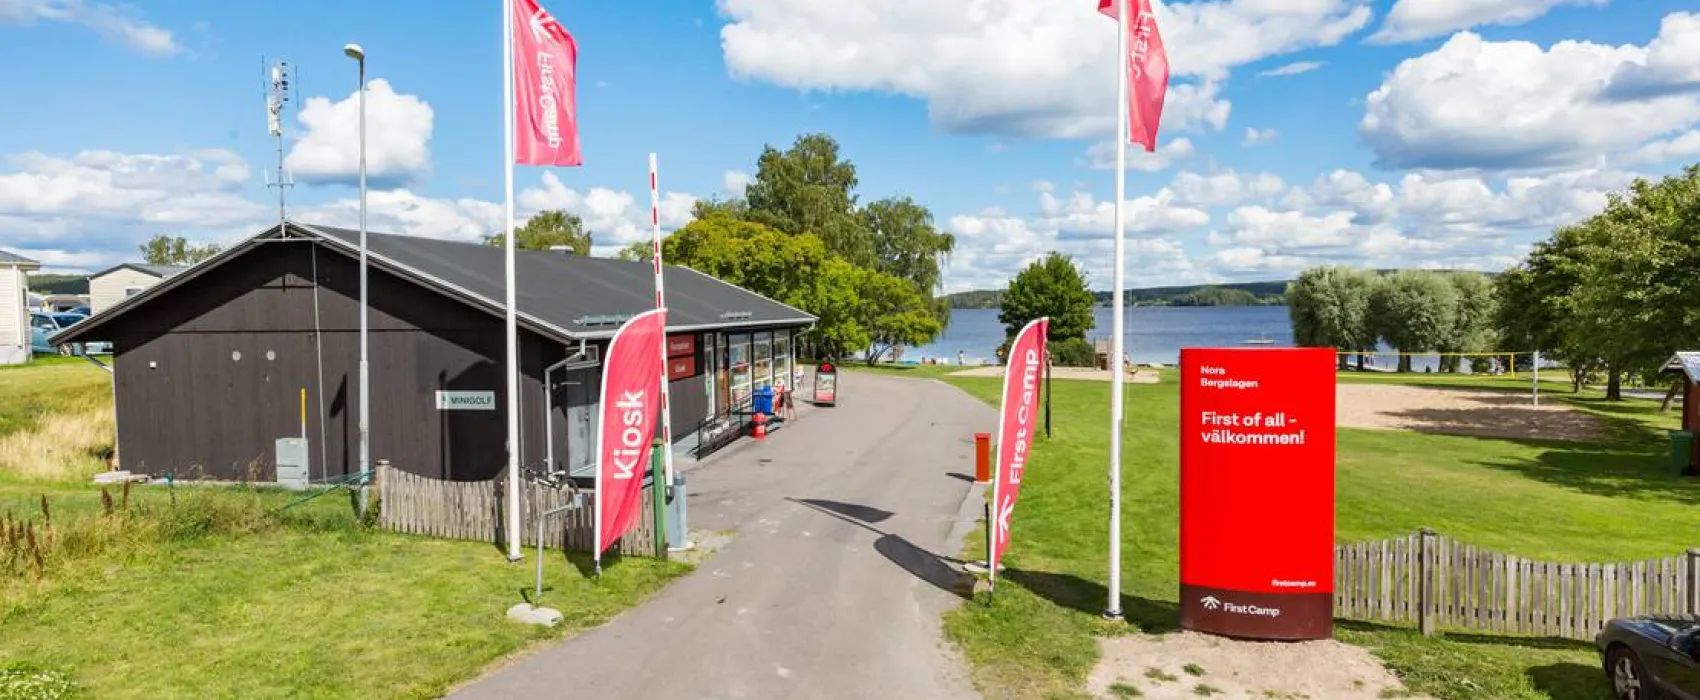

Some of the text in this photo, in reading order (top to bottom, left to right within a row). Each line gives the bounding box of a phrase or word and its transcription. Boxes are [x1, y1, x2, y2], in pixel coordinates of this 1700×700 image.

[1200, 365, 1226, 375] Nora
[1200, 377, 1259, 389] Bergslagen
[451, 396, 492, 405] MINIGOLF
[1010, 348, 1040, 484] First Camp
[1201, 411, 1240, 426] First
[1243, 412, 1262, 427] of
[1265, 412, 1285, 427] all
[614, 390, 645, 479] Kiosk
[1201, 429, 1305, 445] välkommen!
[1223, 602, 1280, 617] First Camp
